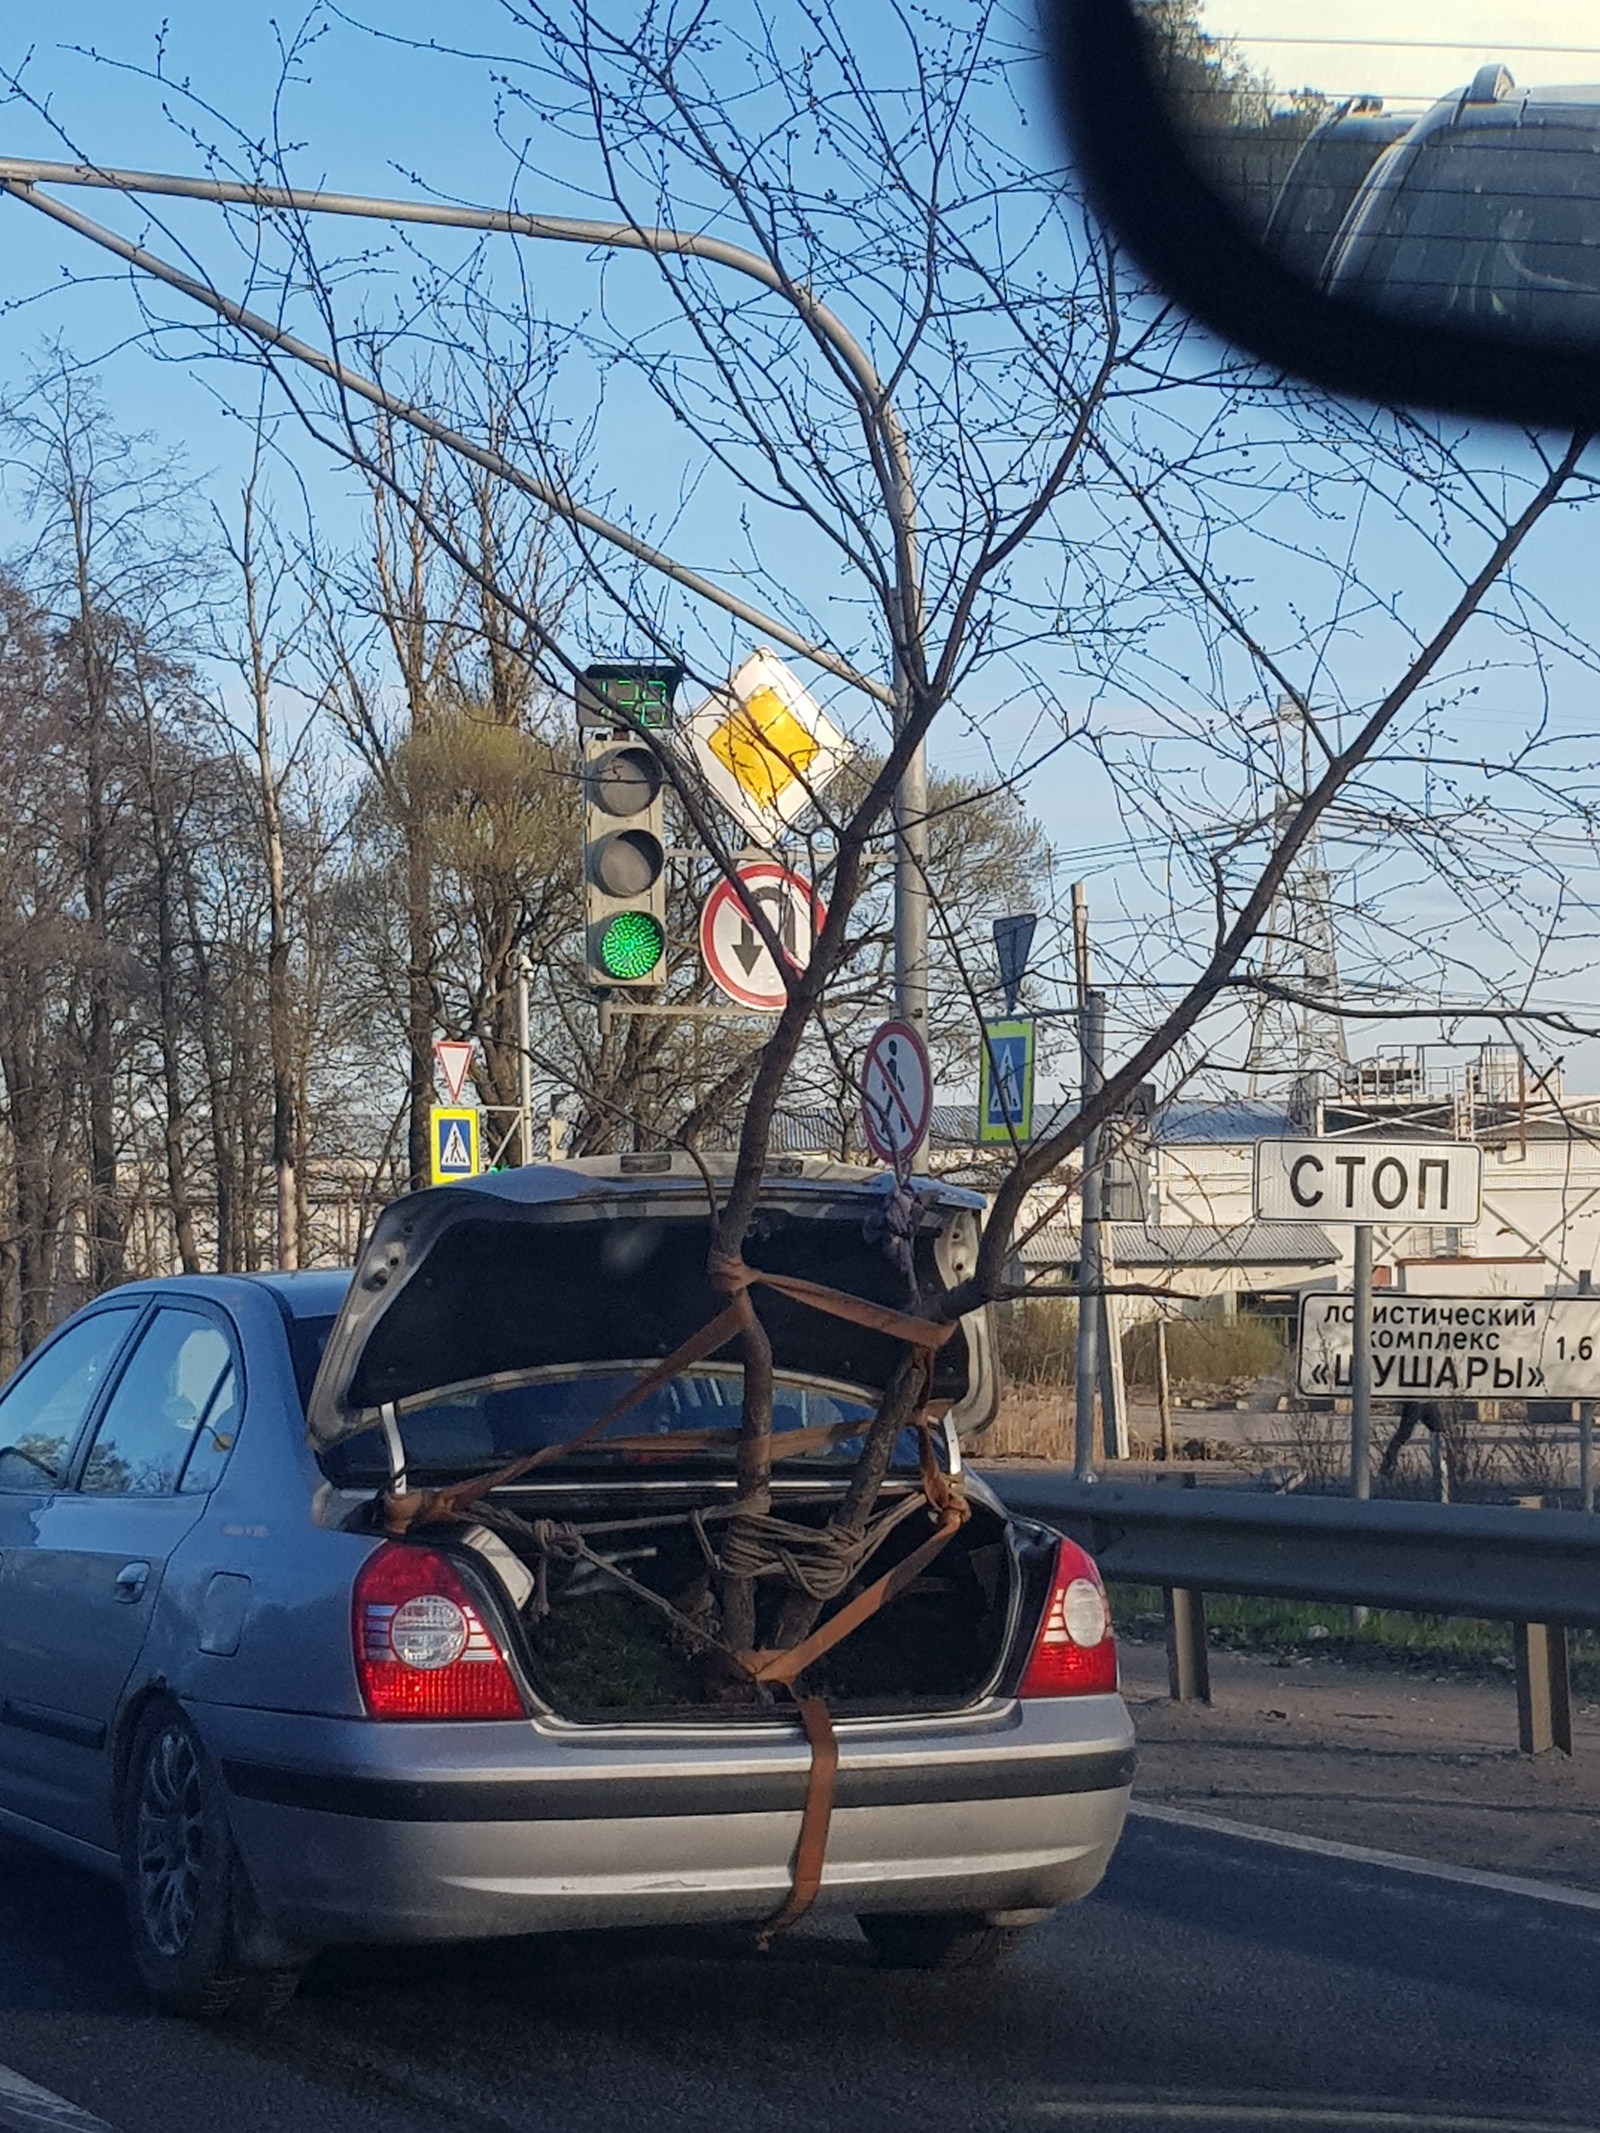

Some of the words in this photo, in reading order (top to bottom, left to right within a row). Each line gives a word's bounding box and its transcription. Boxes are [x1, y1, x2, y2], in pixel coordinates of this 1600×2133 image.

[1289, 1154, 1450, 1210] СТОП
[1323, 1301, 1536, 1327] лоистический
[1555, 1335, 1594, 1363] 1,6
